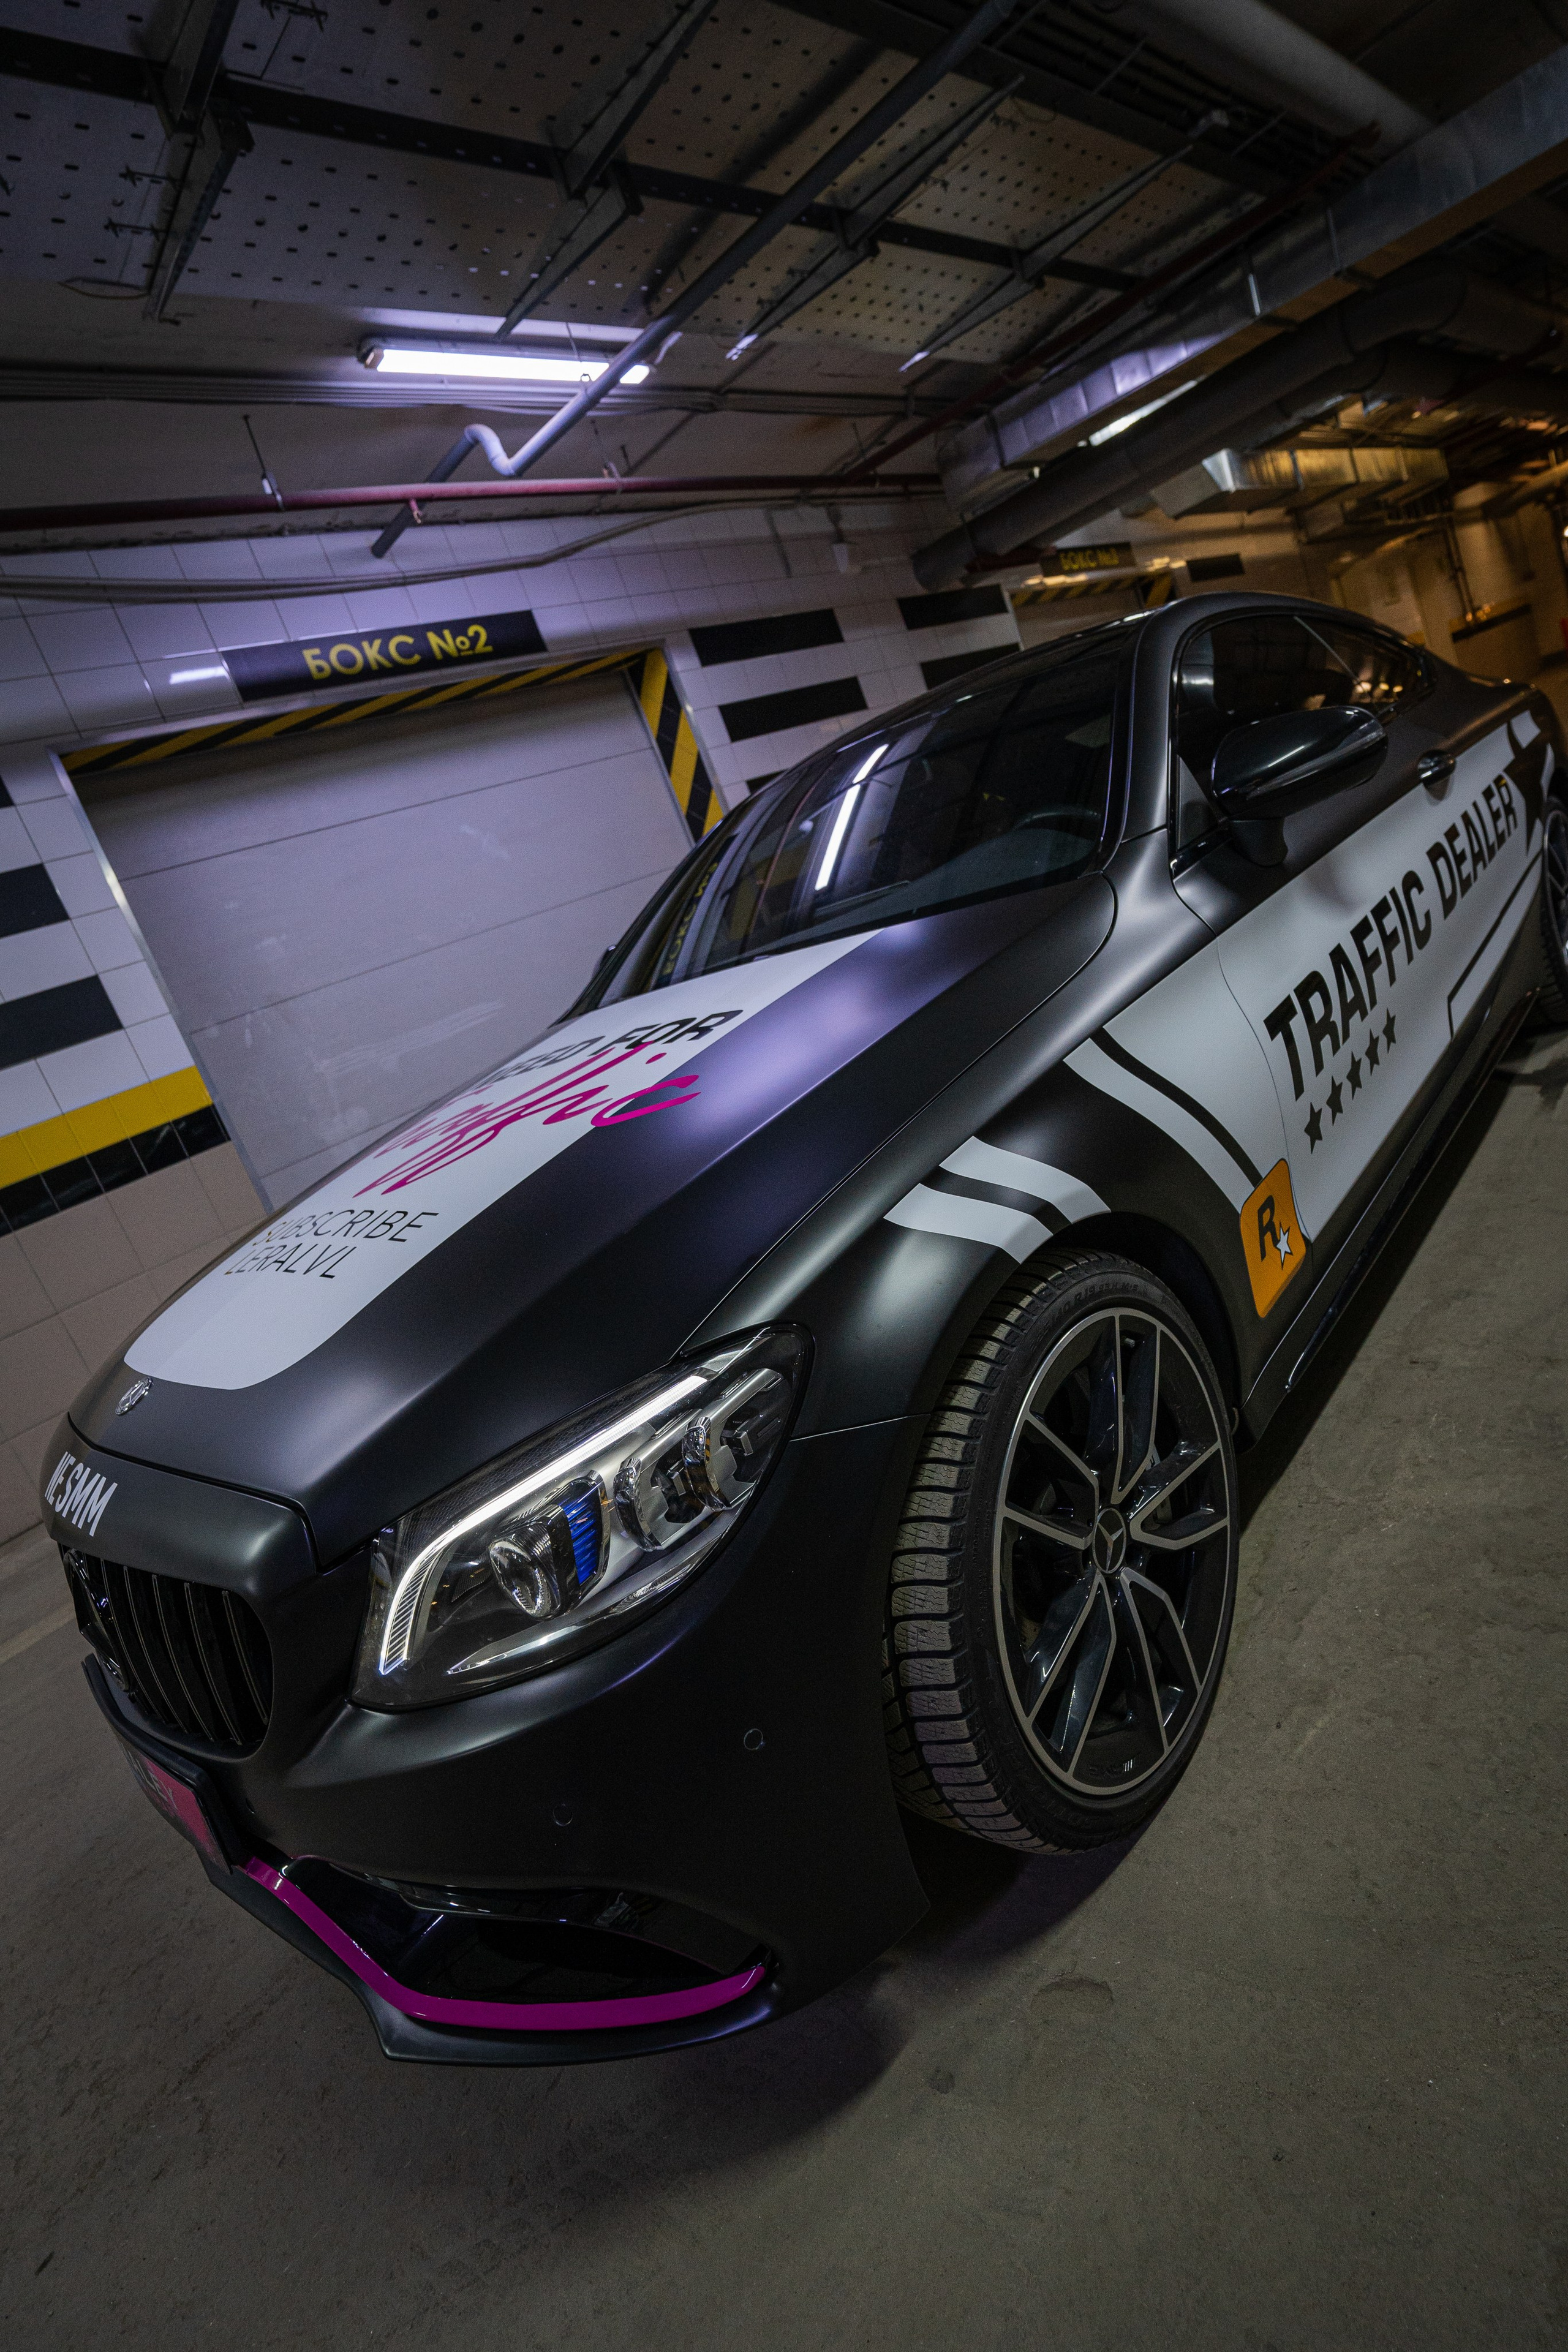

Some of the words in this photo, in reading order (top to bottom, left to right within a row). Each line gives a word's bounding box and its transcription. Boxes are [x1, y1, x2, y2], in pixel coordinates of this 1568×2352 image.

[302, 635, 421, 680] БОКС
[426, 624, 494, 660] №2
[1262, 870, 1432, 1102] TRAFFIC
[1425, 774, 1518, 920] DEALER
[589, 1009, 744, 1056] FOR
[252, 1210, 439, 1246] SUBSCRIBE
[1257, 1195, 1280, 1262] R
[224, 1243, 356, 1280] LERALVL
